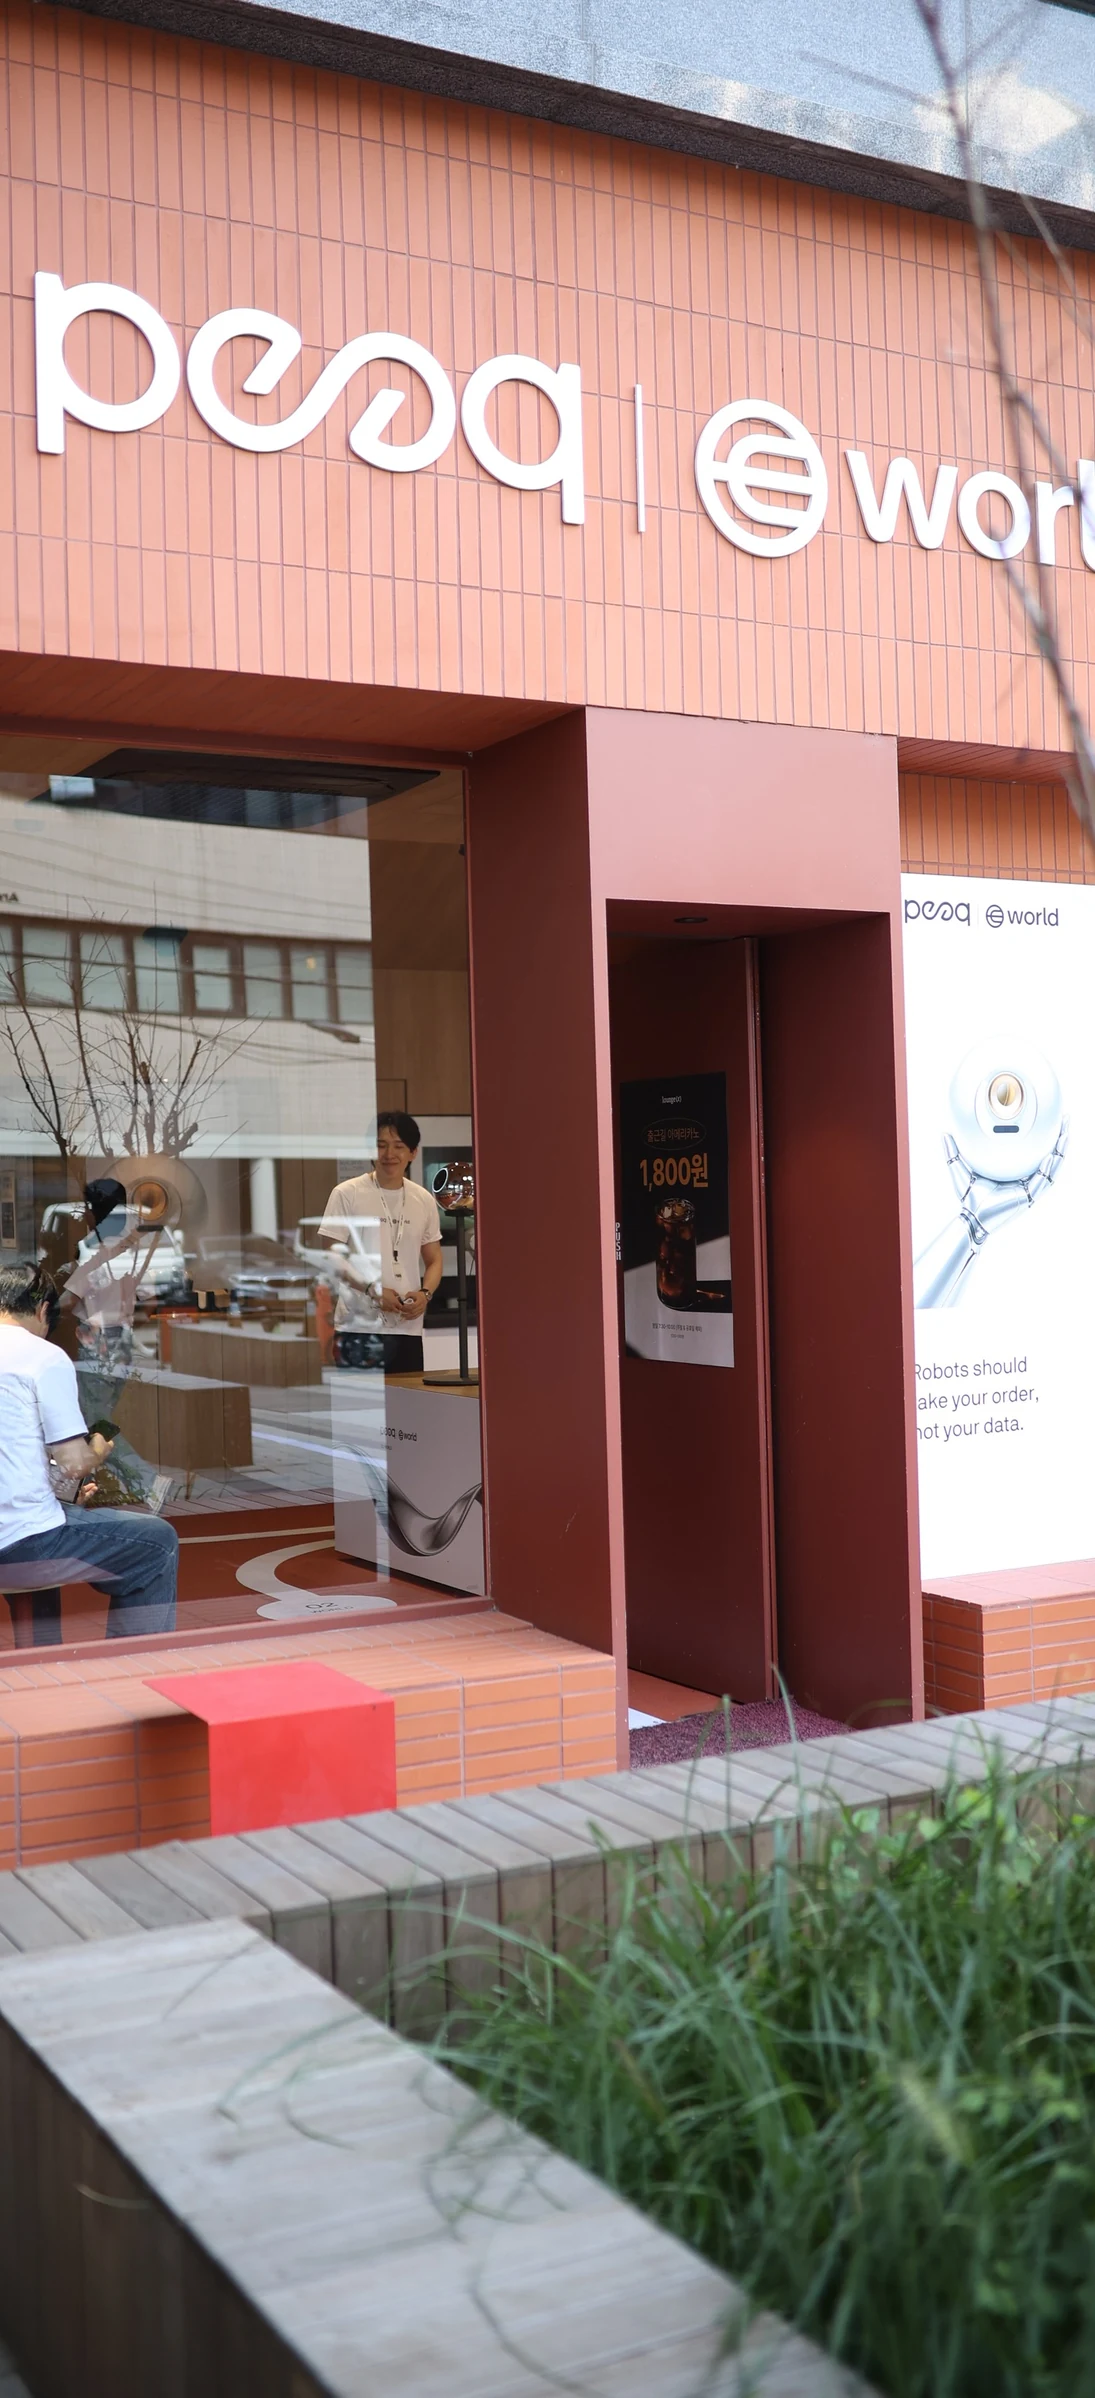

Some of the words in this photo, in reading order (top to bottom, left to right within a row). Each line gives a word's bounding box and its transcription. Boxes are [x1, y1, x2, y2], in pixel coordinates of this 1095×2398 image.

[844, 448, 1095, 574] worl
[1007, 907, 1059, 927] world
[667, 1126, 700, 1140] 아메리카노
[639, 1152, 709, 1192] 1,800원
[914, 1362, 969, 1381] Robots
[973, 1356, 1028, 1377] should
[917, 1393, 948, 1411] ake
[951, 1391, 988, 1412] your
[991, 1386, 1039, 1404] order,
[943, 1421, 980, 1442] your
[983, 1416, 1024, 1434] data.
